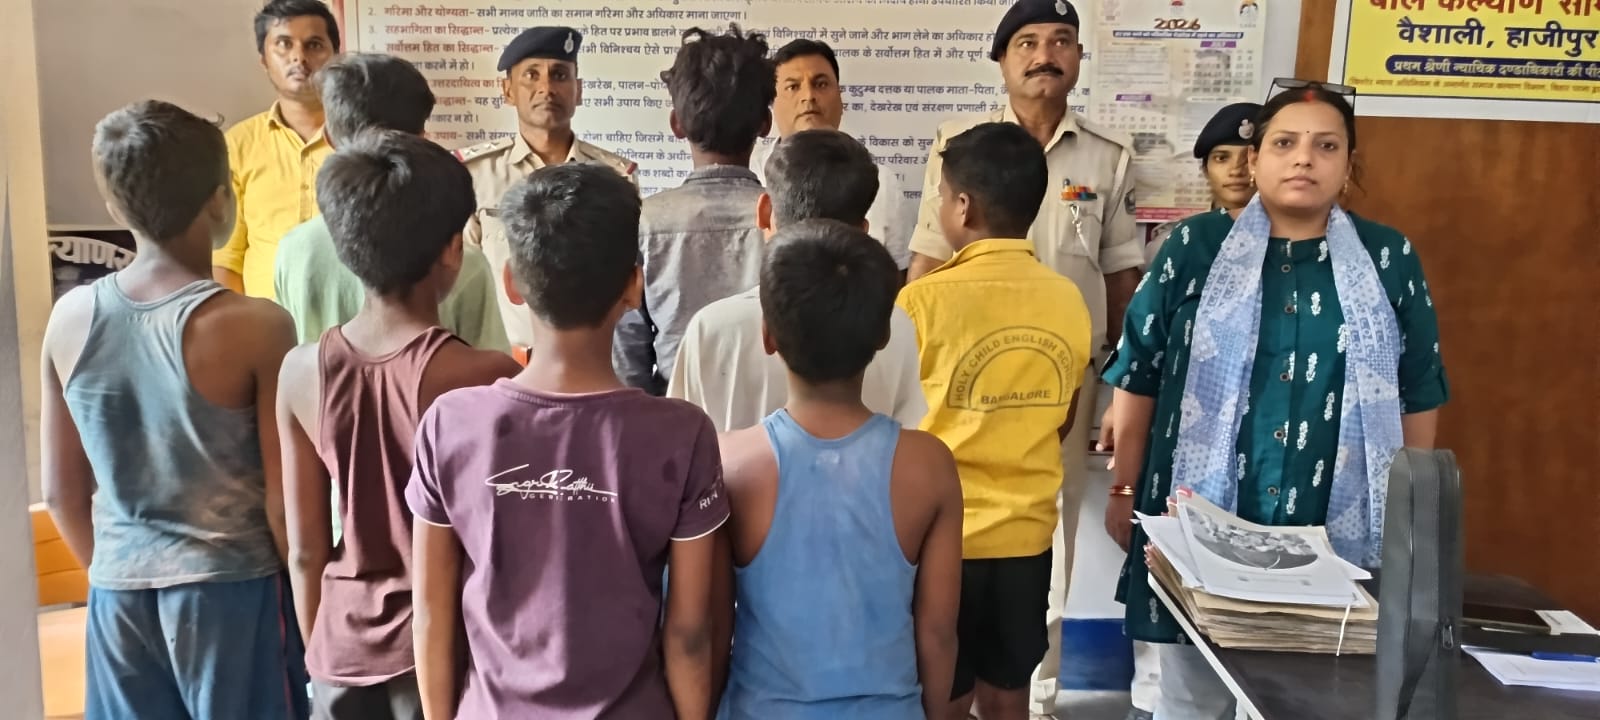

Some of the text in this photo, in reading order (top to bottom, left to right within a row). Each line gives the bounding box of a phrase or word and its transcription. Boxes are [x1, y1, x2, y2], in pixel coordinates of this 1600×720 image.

[384, 5, 412, 16] गरिमा
[415, 5, 432, 16] और
[477, 5, 496, 17] सभी
[499, 8, 524, 17] मानव
[527, 6, 548, 17] जाति
[551, 9, 563, 18] का
[566, 9, 592, 18] समान
[595, 7, 623, 18] गरिमा
[626, 7, 643, 18] और
[646, 7, 684, 19] अधिकार
[686, 11, 708, 19] माना
[434, 26, 446, 34] का
[590, 24, 607, 36] हित
[609, 27, 622, 36] पर
[624, 28, 649, 36] प्रभाव
[652, 25, 676, 37] डालने
[819, 27, 828, 39] में
[830, 27, 846, 42] सुने
[849, 28, 869, 39] जाने
[871, 28, 889, 40] और
[892, 31, 911, 40] भाग
[913, 28, 930, 40] लेने
[932, 31, 944, 40] का
[946, 29, 984, 41] अधिकार
[1397, 16, 1600, 57] वैशाली, हाजीपुर
[423, 40, 440, 52] हित
[442, 43, 455, 52] का
[644, 43, 659, 55] ऐसे
[863, 45, 872, 57] के
[875, 46, 910, 58] सर्वोत्तम
[913, 46, 930, 58] हित
[933, 47, 942, 58] में
[945, 47, 964, 59] और
[967, 47, 983, 62] पूर्ण
[425, 59, 446, 70] करने
[1393, 60, 1421, 72] प्रथम
[1424, 58, 1451, 73] श्रेणी
[1453, 60, 1496, 74] न्यायिक
[1566, 62, 1582, 77] की
[483, 79, 494, 88] का
[904, 86, 915, 94] या
[917, 85, 944, 95] पालक
[474, 97, 488, 106] यह
[594, 95, 613, 107] सभी
[617, 98, 640, 107] उपाय
[643, 96, 662, 108] किए
[870, 100, 902, 112] देखरेख
[957, 101, 986, 113] प्रणाली
[466, 129, 486, 140] सभी
[606, 130, 632, 142] चाहिए
[869, 135, 899, 146] विकास
[902, 136, 914, 147] को
[656, 149, 665, 159] के
[888, 153, 918, 165] परिवार
[955, 370, 971, 401] HOLY
[970, 339, 1000, 367] CHILD
[1003, 333, 1059, 352] ENGLISH
